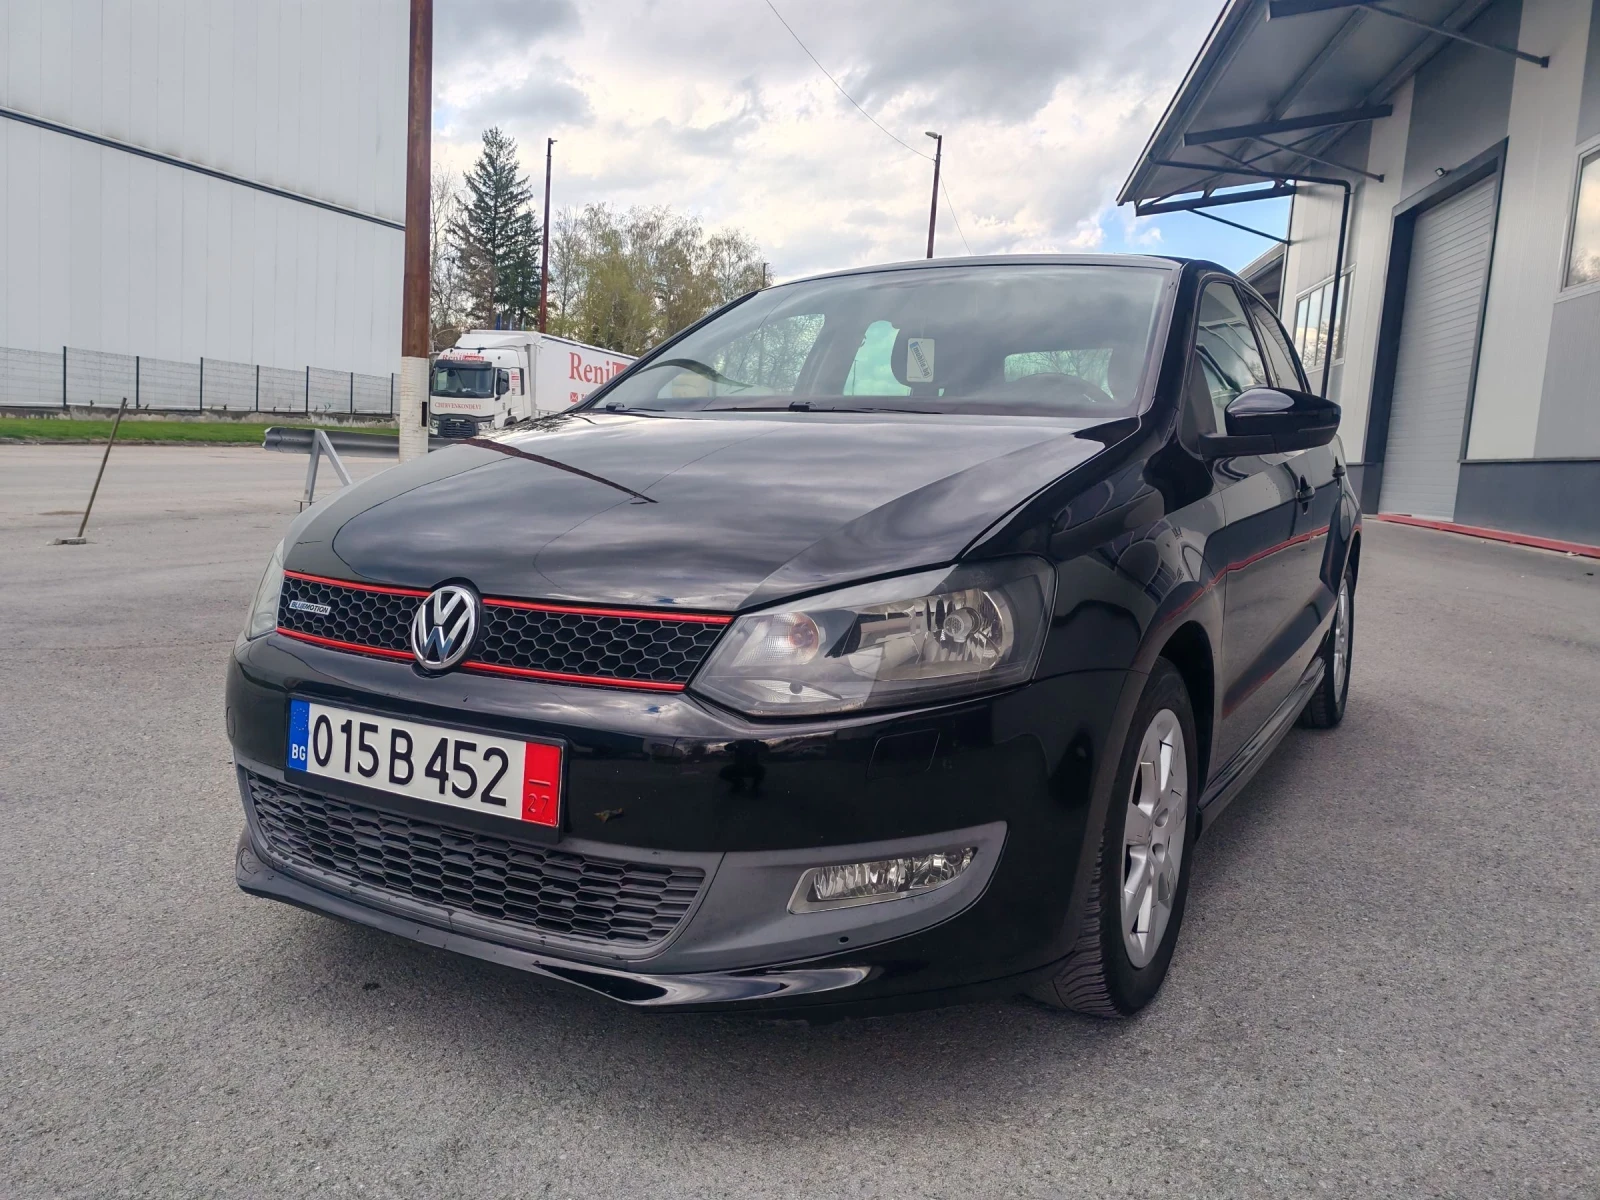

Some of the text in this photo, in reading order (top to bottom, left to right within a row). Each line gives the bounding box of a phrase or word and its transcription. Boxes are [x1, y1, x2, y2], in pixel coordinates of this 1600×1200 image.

[569, 352, 610, 385] Reni
[290, 601, 329, 614] BLUEMOTION
[291, 743, 306, 761] BG
[527, 793, 551, 816] 27
